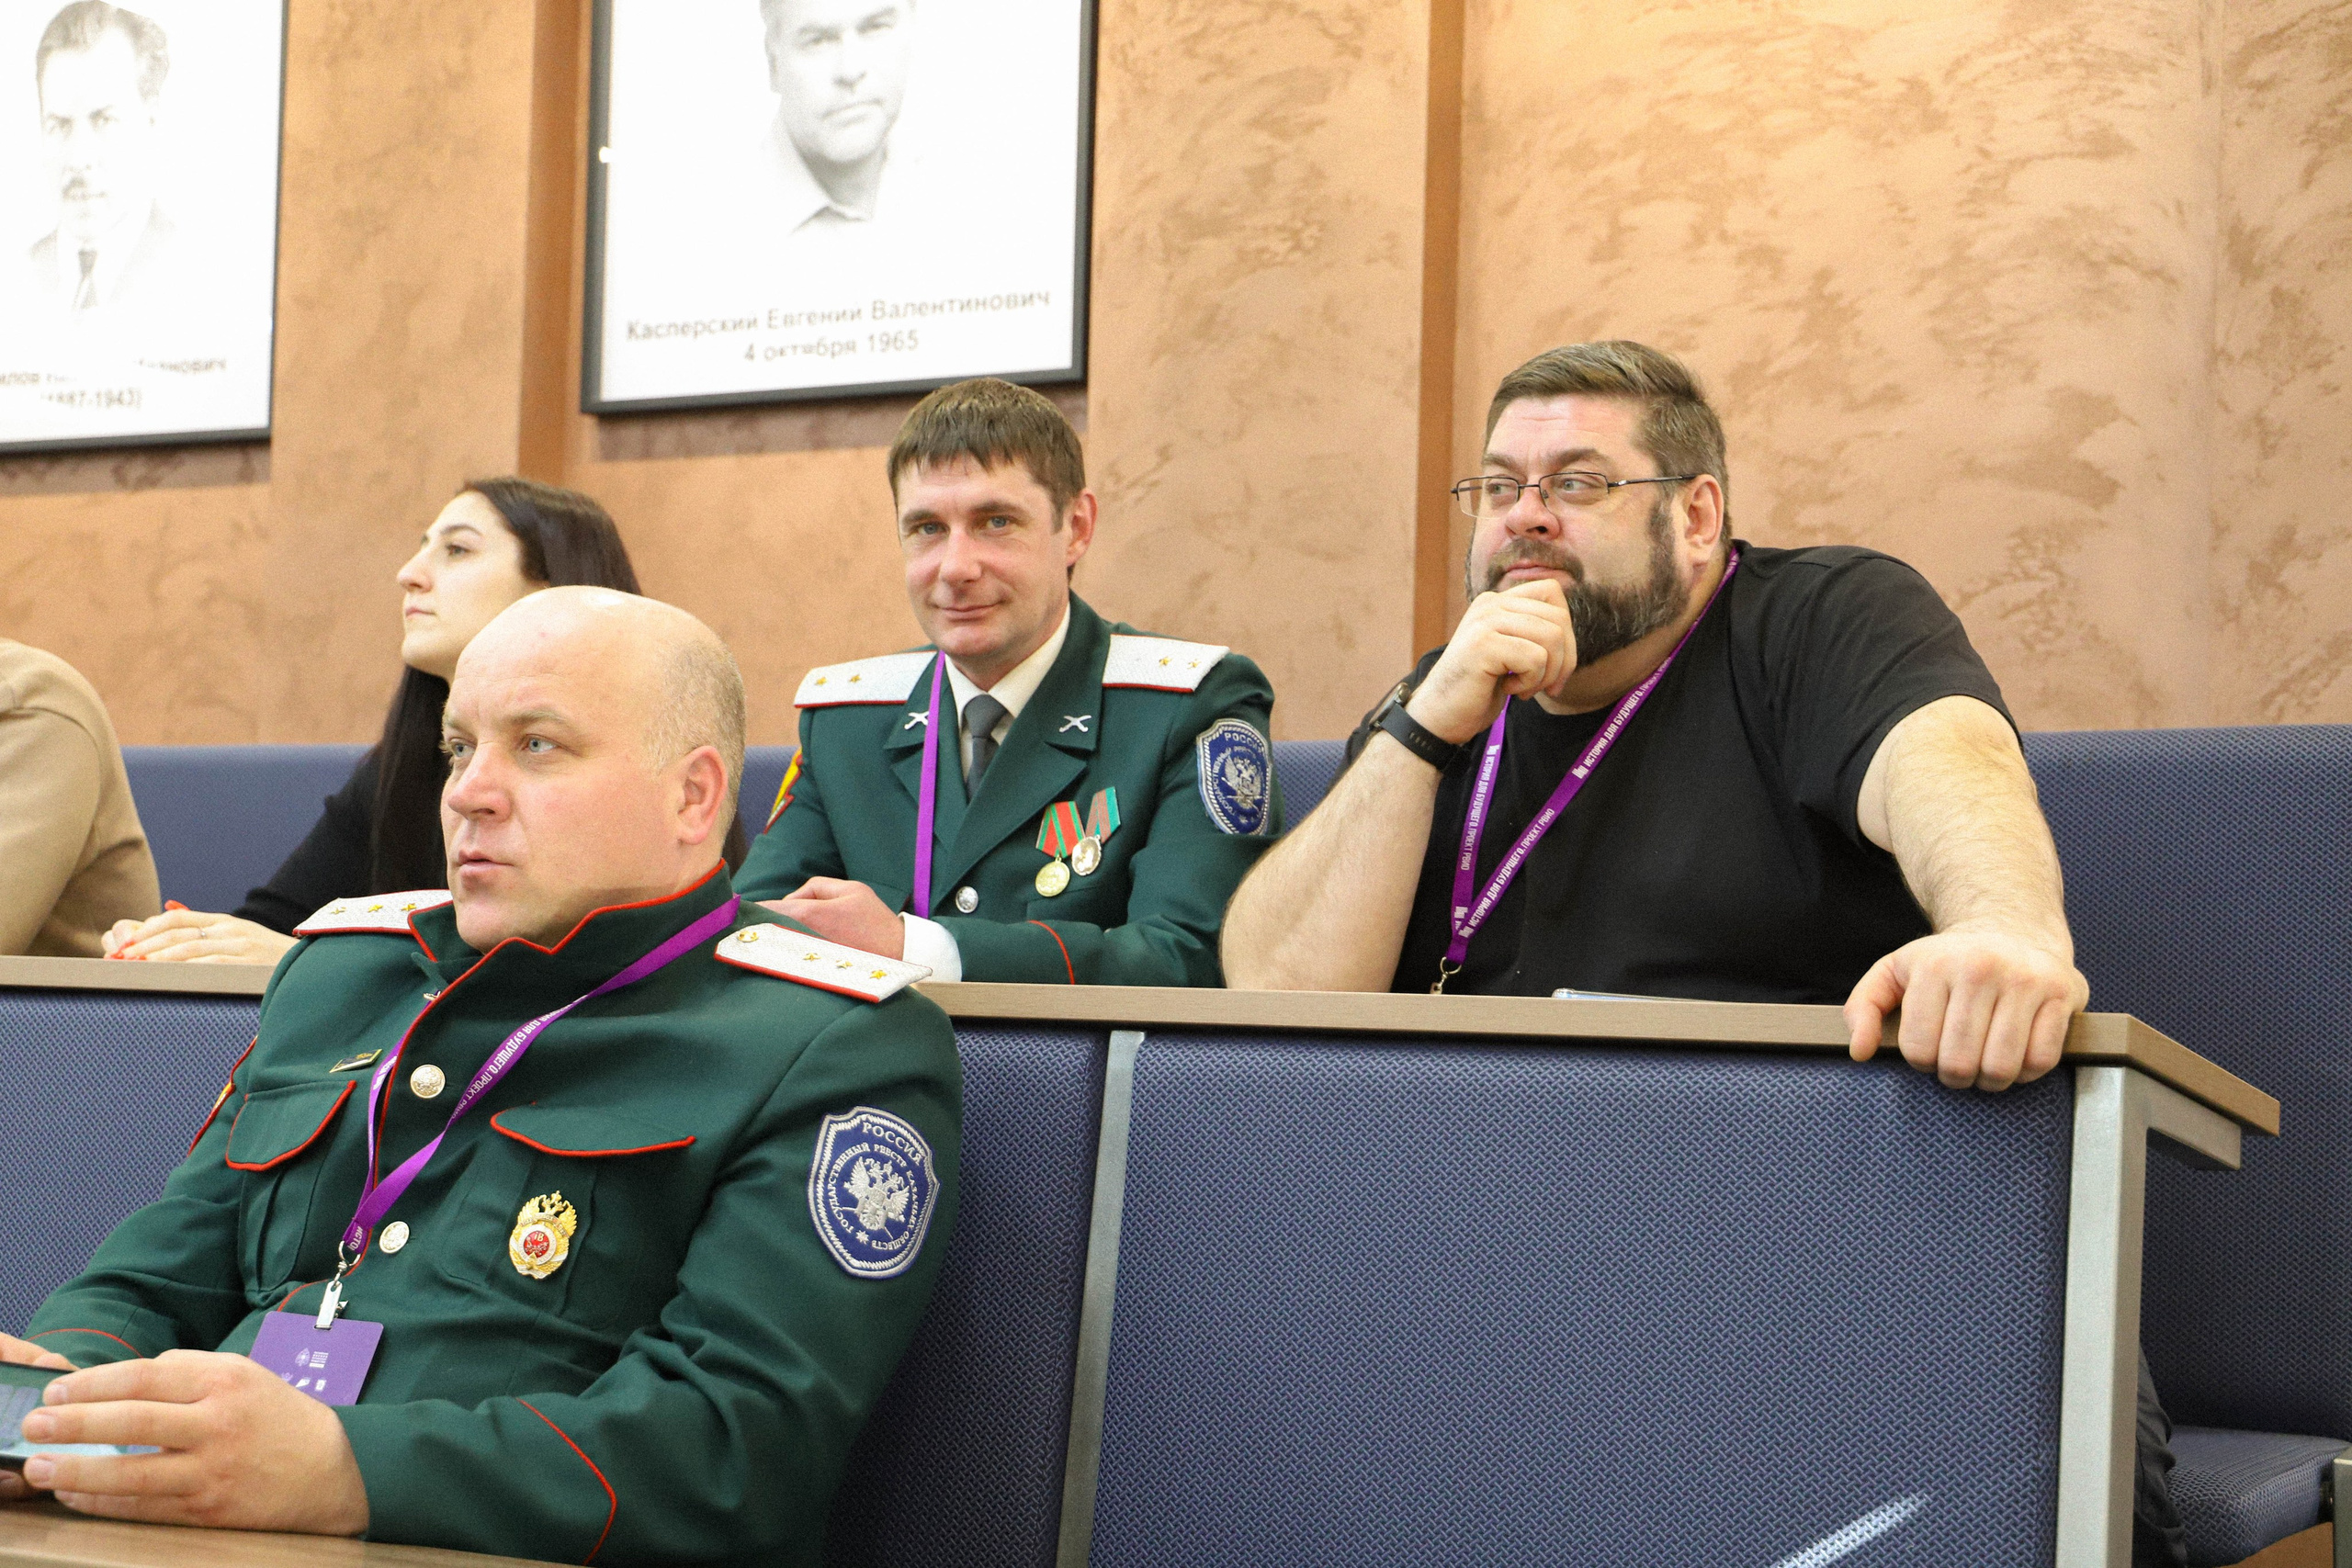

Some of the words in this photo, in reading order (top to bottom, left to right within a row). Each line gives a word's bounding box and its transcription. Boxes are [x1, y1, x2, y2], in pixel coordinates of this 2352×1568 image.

[872, 291, 1050, 321] Валентинович
[744, 343, 755, 361] 4
[763, 337, 857, 362] октября
[868, 329, 918, 353] 1965
[1583, 737, 1609, 767] ИСТОРИЯ
[1603, 723, 1619, 740] ДЛЯ
[1613, 690, 1644, 728] БУДУЩЕГО.
[1476, 780, 1488, 794] ДЛЯ
[1464, 828, 1477, 851] ПРОЕКТ
[1461, 852, 1472, 871] РВИО
[1467, 897, 1492, 928] ИСТОРИЯ
[1487, 883, 1502, 901] ДЛЯ
[1496, 847, 1526, 886] БУДУЩЕГО.
[1521, 824, 1543, 849] ПРОЕКТ
[1537, 807, 1555, 827] РВИО
[522, 1020, 542, 1034] ДЛЯ
[486, 1032, 526, 1074] БУДУЩЕГО.
[466, 1070, 492, 1100] ПРОЕКТ
[863, 1122, 922, 1167] РОССИЯ
[874, 1144, 907, 1168] РЕЕСТР
